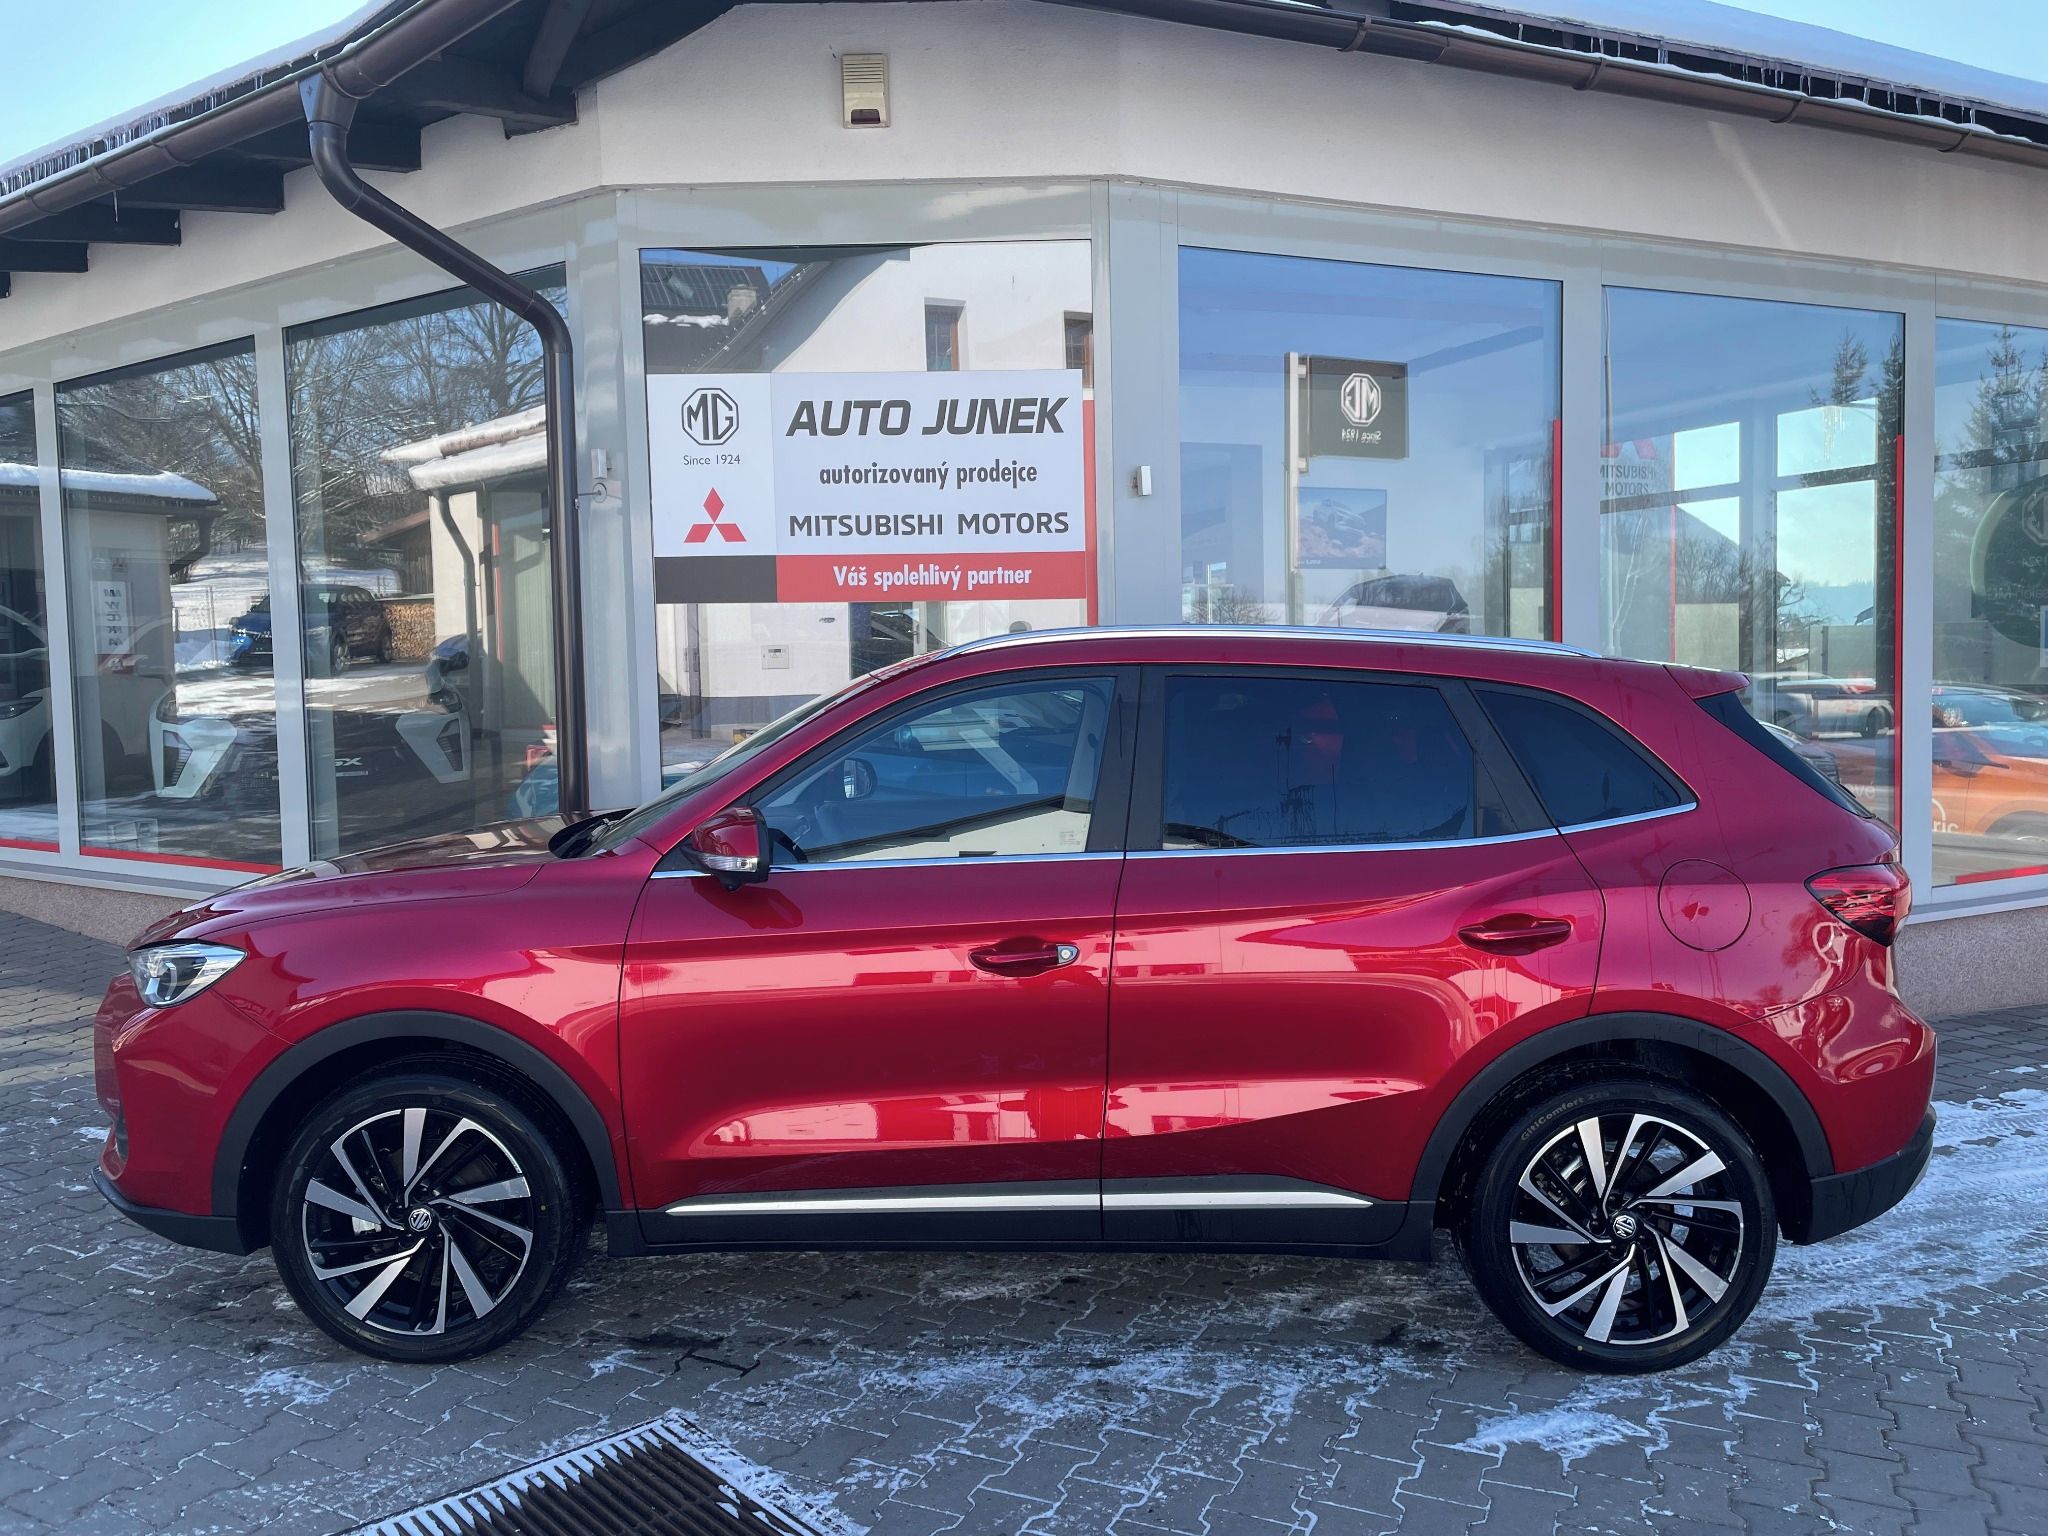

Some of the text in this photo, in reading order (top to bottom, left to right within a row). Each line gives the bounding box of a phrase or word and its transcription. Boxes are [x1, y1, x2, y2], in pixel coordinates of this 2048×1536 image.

[687, 393, 734, 440] MG
[786, 397, 1069, 436] AUTO JUNEK
[683, 454, 741, 466] Since 1924
[820, 459, 1037, 490] autorizovaný prodejce
[1605, 482, 1648, 497] MOTORS
[790, 511, 1069, 537] MITSUBISHI MOTORS
[833, 563, 1032, 591] Váš spolehlivý partner
[335, 756, 364, 767] SX
